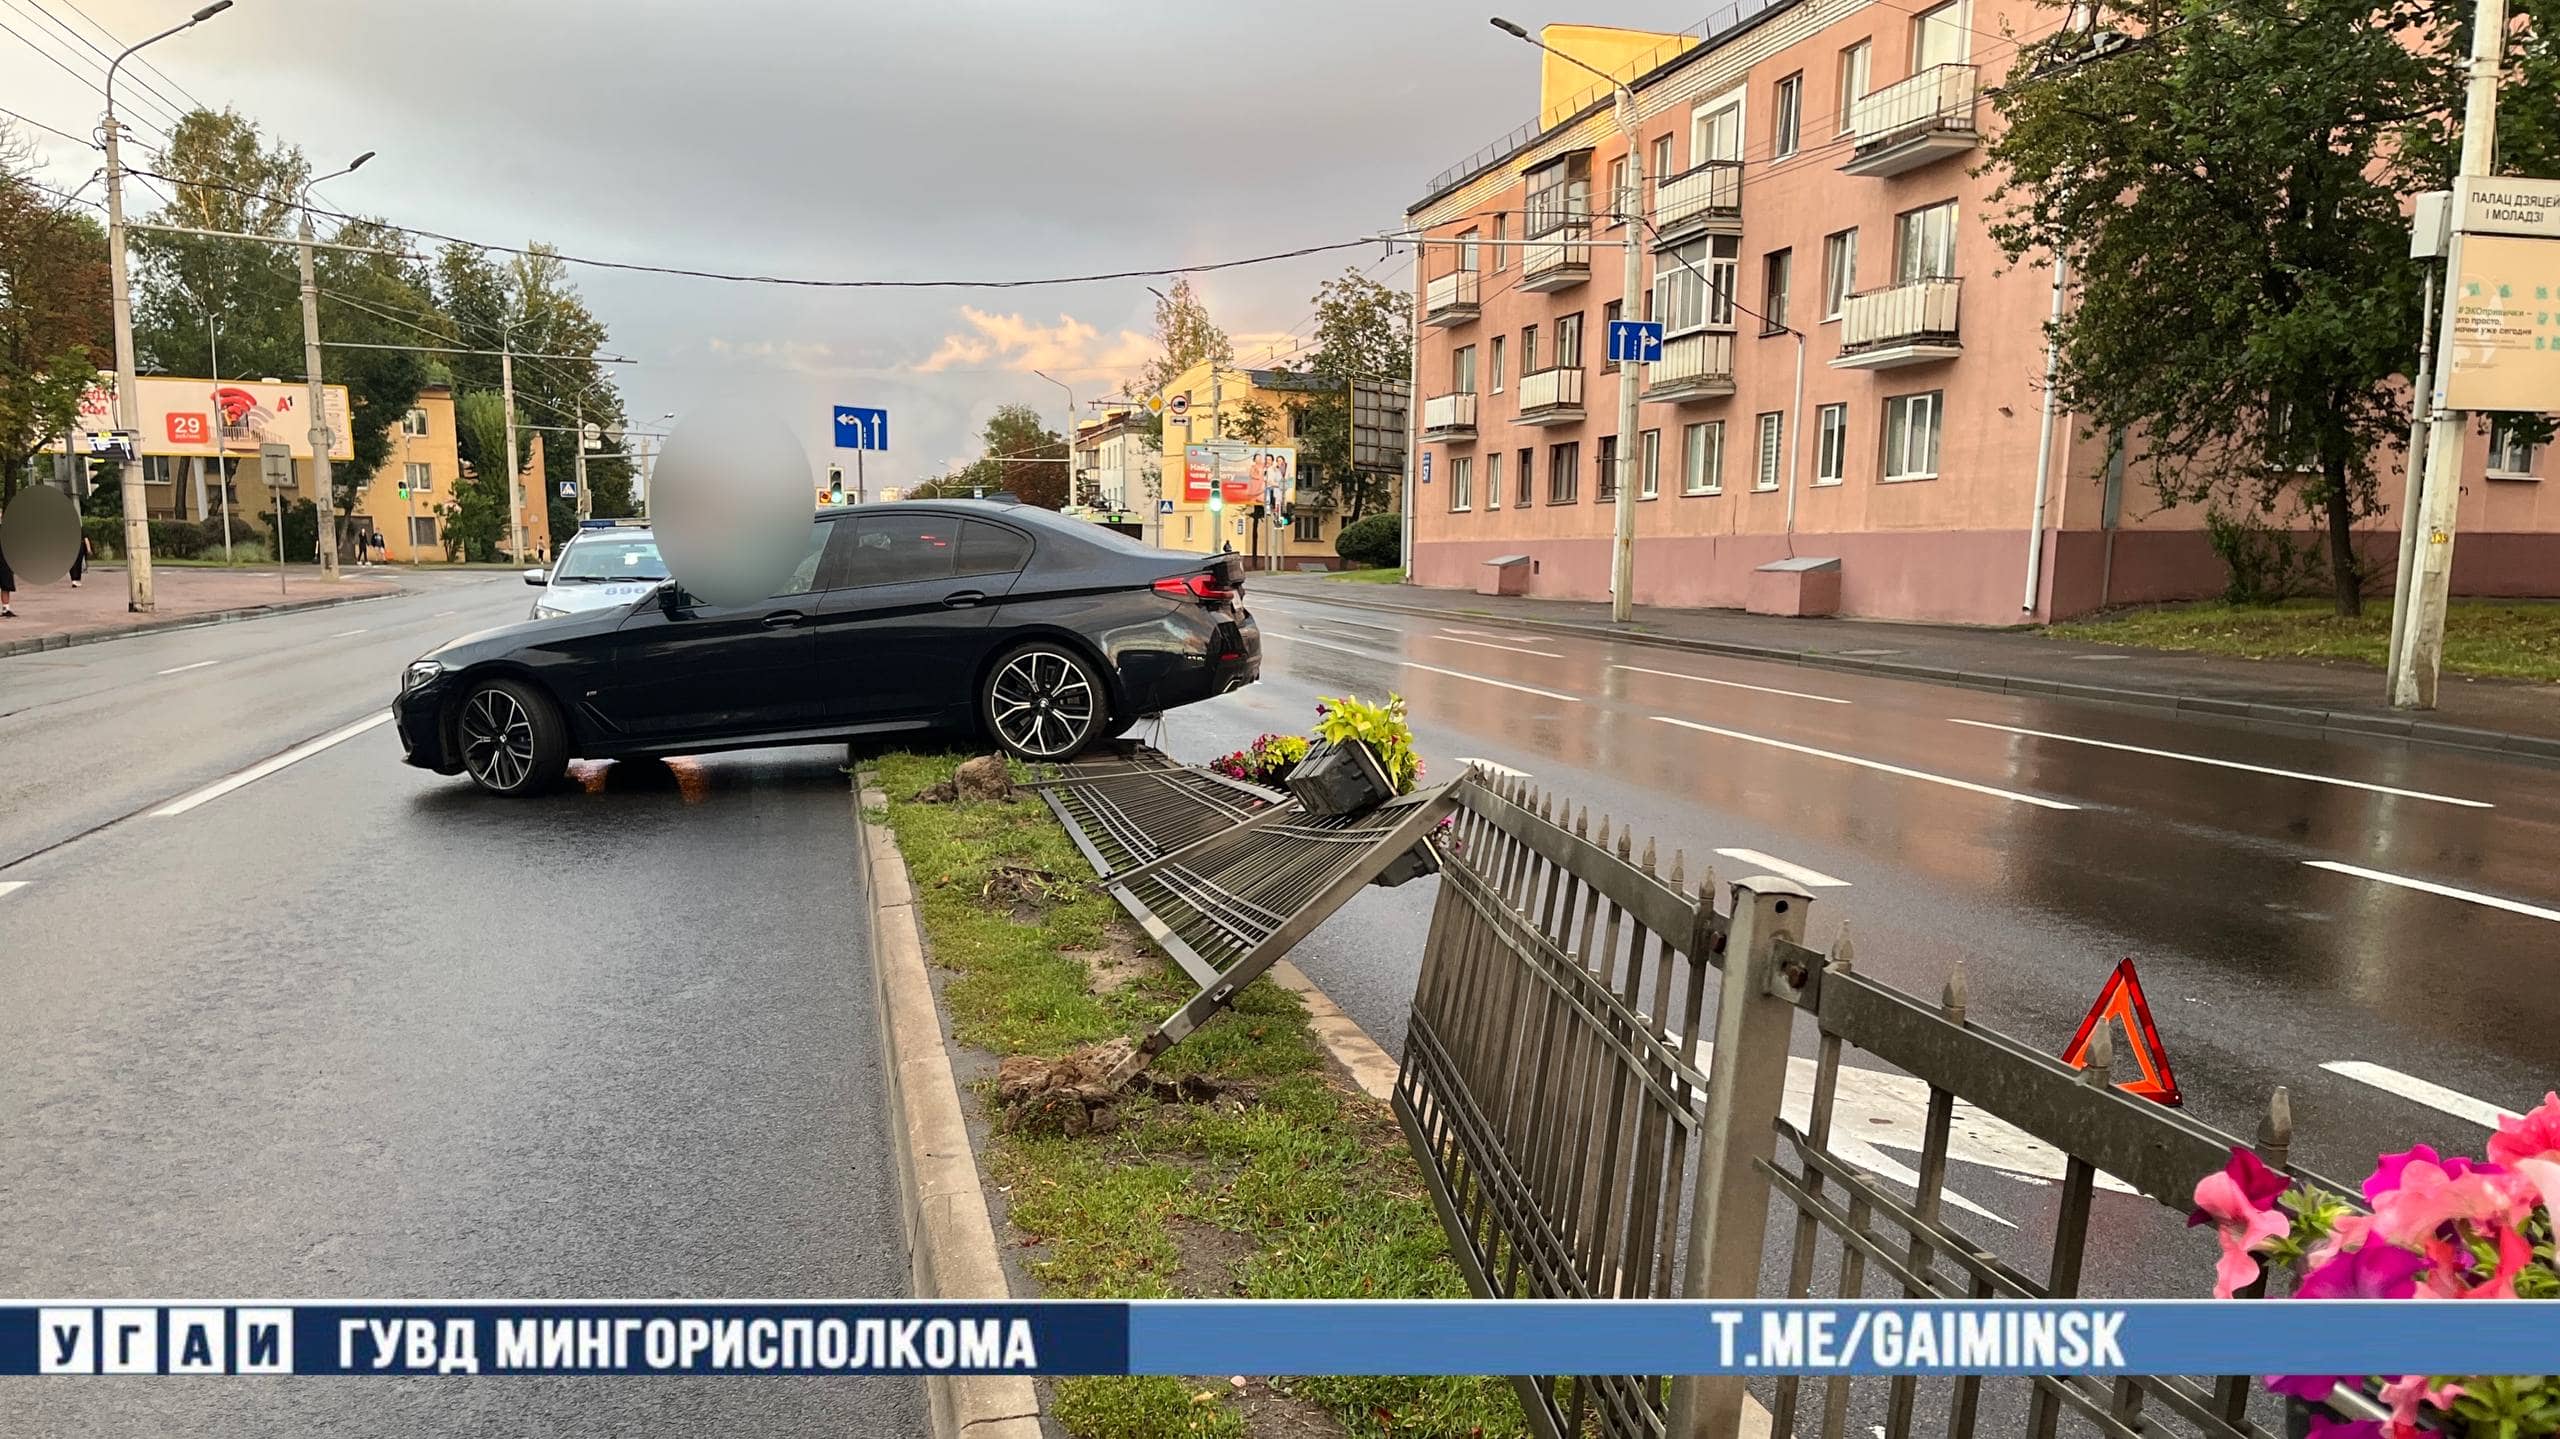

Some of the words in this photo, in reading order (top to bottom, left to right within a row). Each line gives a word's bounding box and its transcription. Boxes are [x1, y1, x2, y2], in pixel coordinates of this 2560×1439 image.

[2472, 192, 2512, 206] ПАЛАЦ
[2514, 194, 2560, 208] ДЗЯЦЕЙ
[2492, 209, 2544, 223] МОЛАДЗІ
[174, 416, 200, 434] 29
